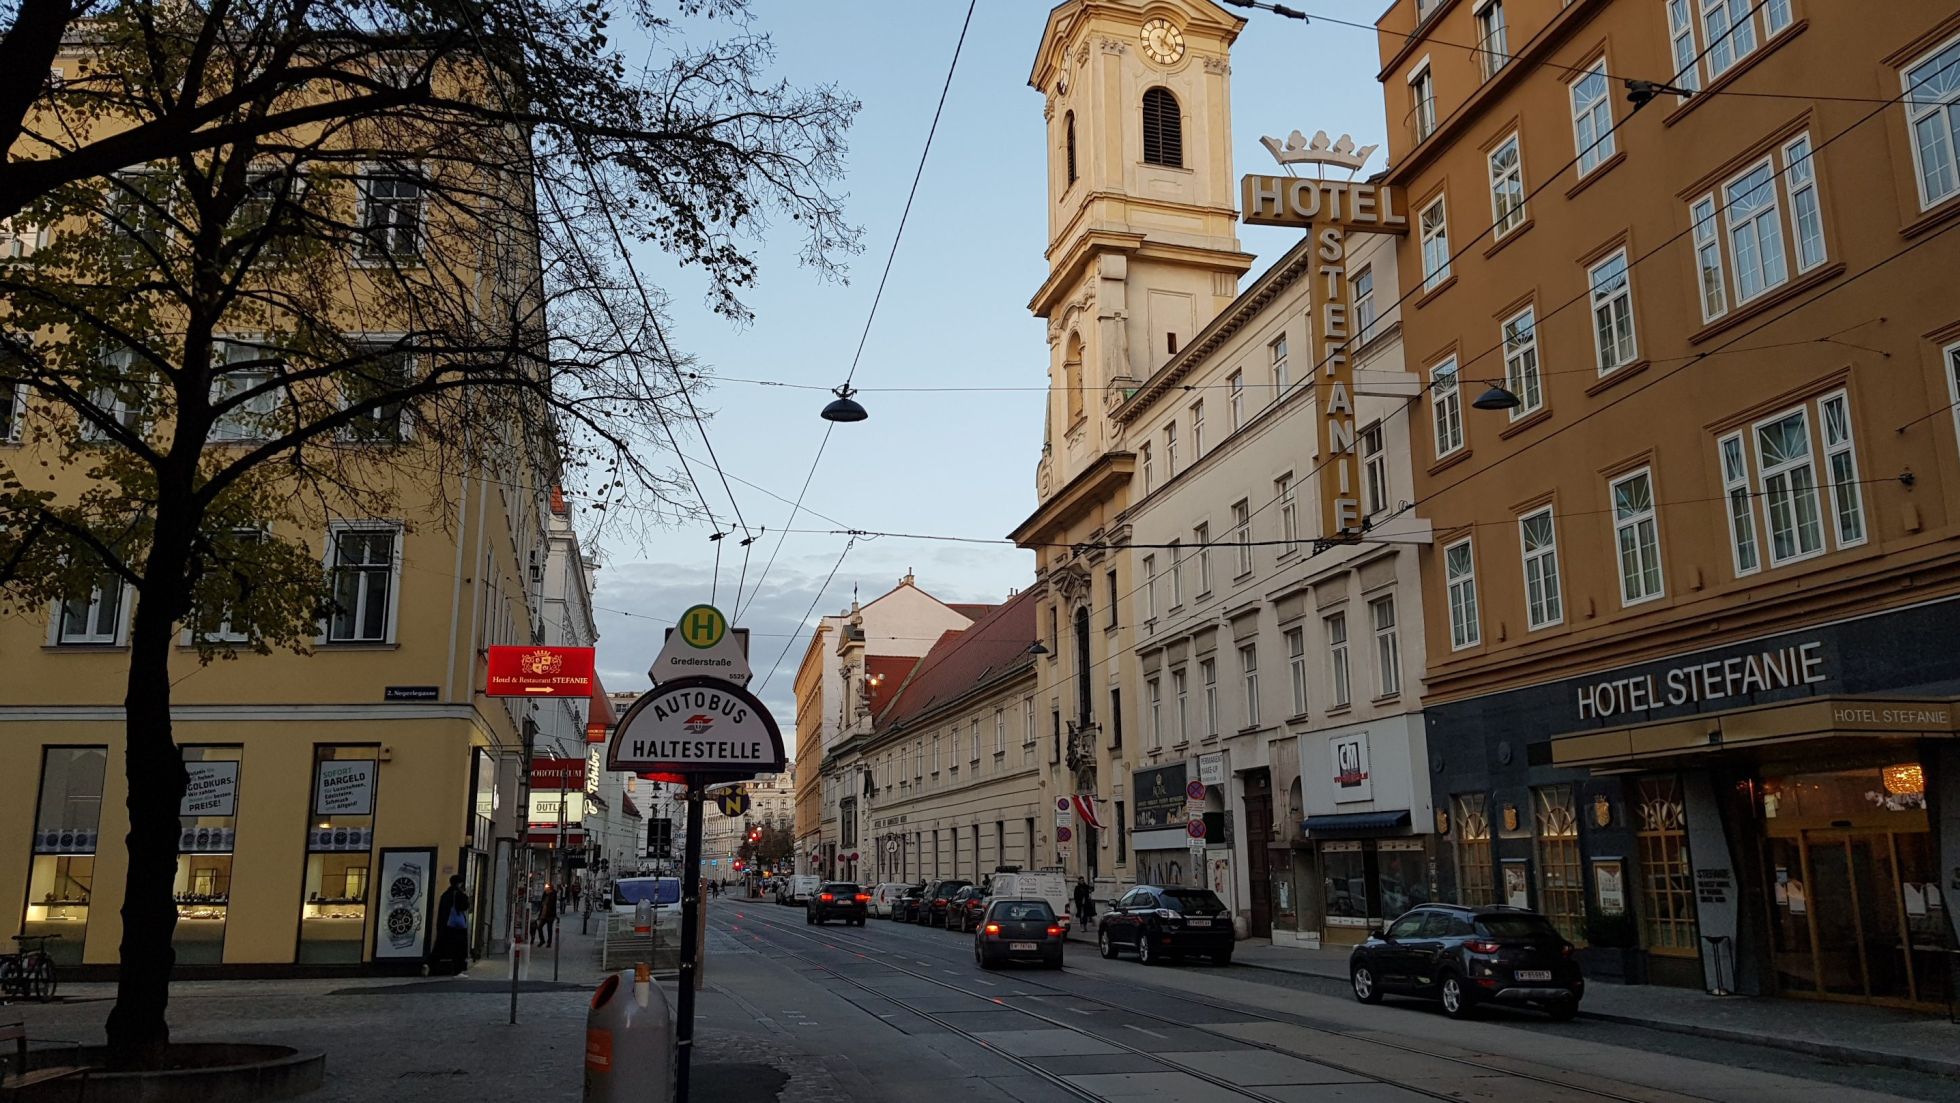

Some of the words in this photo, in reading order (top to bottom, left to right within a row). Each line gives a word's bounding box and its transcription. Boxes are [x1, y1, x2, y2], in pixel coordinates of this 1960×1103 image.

[1252, 176, 1406, 226] HOTEL
[1319, 229, 1358, 537] STEFANIE
[692, 613, 715, 640] H
[671, 657, 732, 668] Gredlerstraße
[492, 676, 511, 684] Hotel
[1578, 674, 1664, 720] HOTEL
[1666, 641, 1827, 706] STEFANIE
[654, 692, 747, 724] AUTOBUS
[1834, 709, 1880, 723] HOTEL
[1882, 710, 1949, 724] STEFANIE
[633, 740, 761, 759] HALTESTELLE
[323, 767, 352, 778] SOFORT
[324, 773, 366, 787] BARGELD
[586, 748, 601, 794] Tchibo
[188, 776, 234, 791] GOLDKURS.
[189, 799, 222, 812] PREISE!
[725, 795, 742, 815] N
